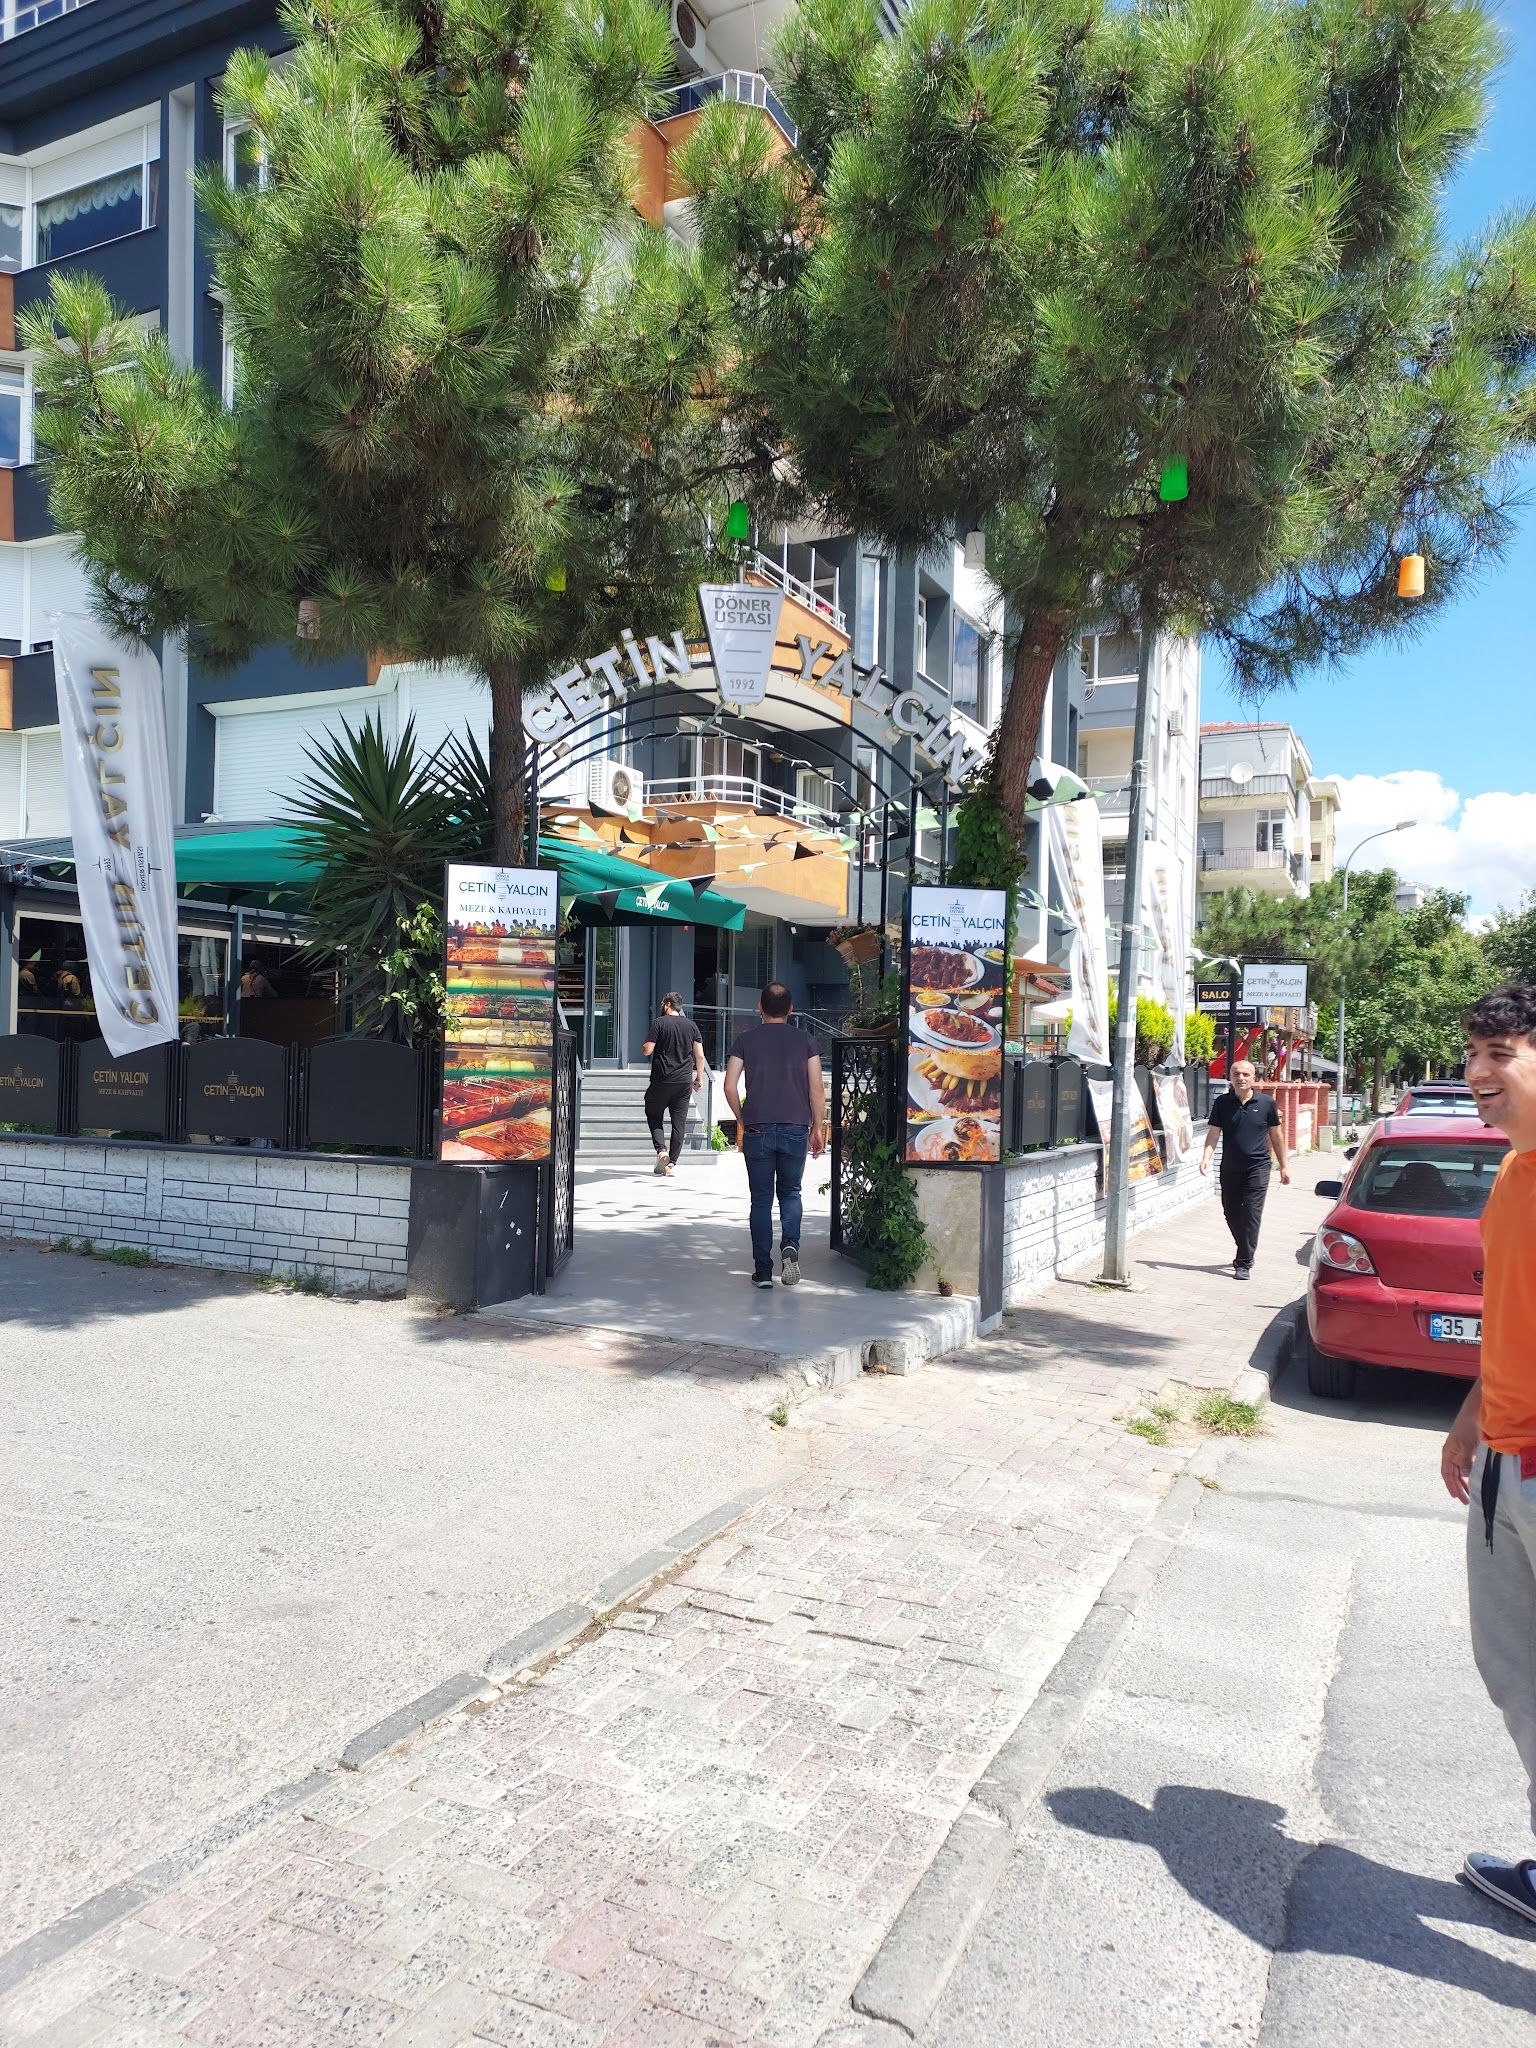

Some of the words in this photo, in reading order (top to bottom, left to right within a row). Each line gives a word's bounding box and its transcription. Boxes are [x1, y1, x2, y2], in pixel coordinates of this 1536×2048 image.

[714, 595, 771, 612] DÖNER
[714, 611, 772, 625] USTASI
[729, 678, 755, 690] 1992
[521, 628, 693, 758] ÇETİN
[794, 633, 983, 793] YALÇIN
[459, 881, 496, 893] ÇETİN
[506, 884, 548, 897] YALÇIN
[459, 904, 487, 913] MEZE
[498, 906, 547, 916] KAHVALTI
[912, 914, 951, 928] ÇETİN
[961, 917, 1005, 930] YALÇIN
[1246, 978, 1270, 986] ÇETİN
[1201, 991, 1231, 999] SALO
[0, 1076, 15, 1088] ETİN
[20, 1078, 44, 1089] YALÇIN
[93, 1069, 118, 1084] ÇETİN
[119, 1071, 149, 1086] YALÇIN
[203, 1083, 229, 1097] ÇETİN
[234, 1086, 265, 1098] YALÇIN
[1443, 1318, 1464, 1336] 35
